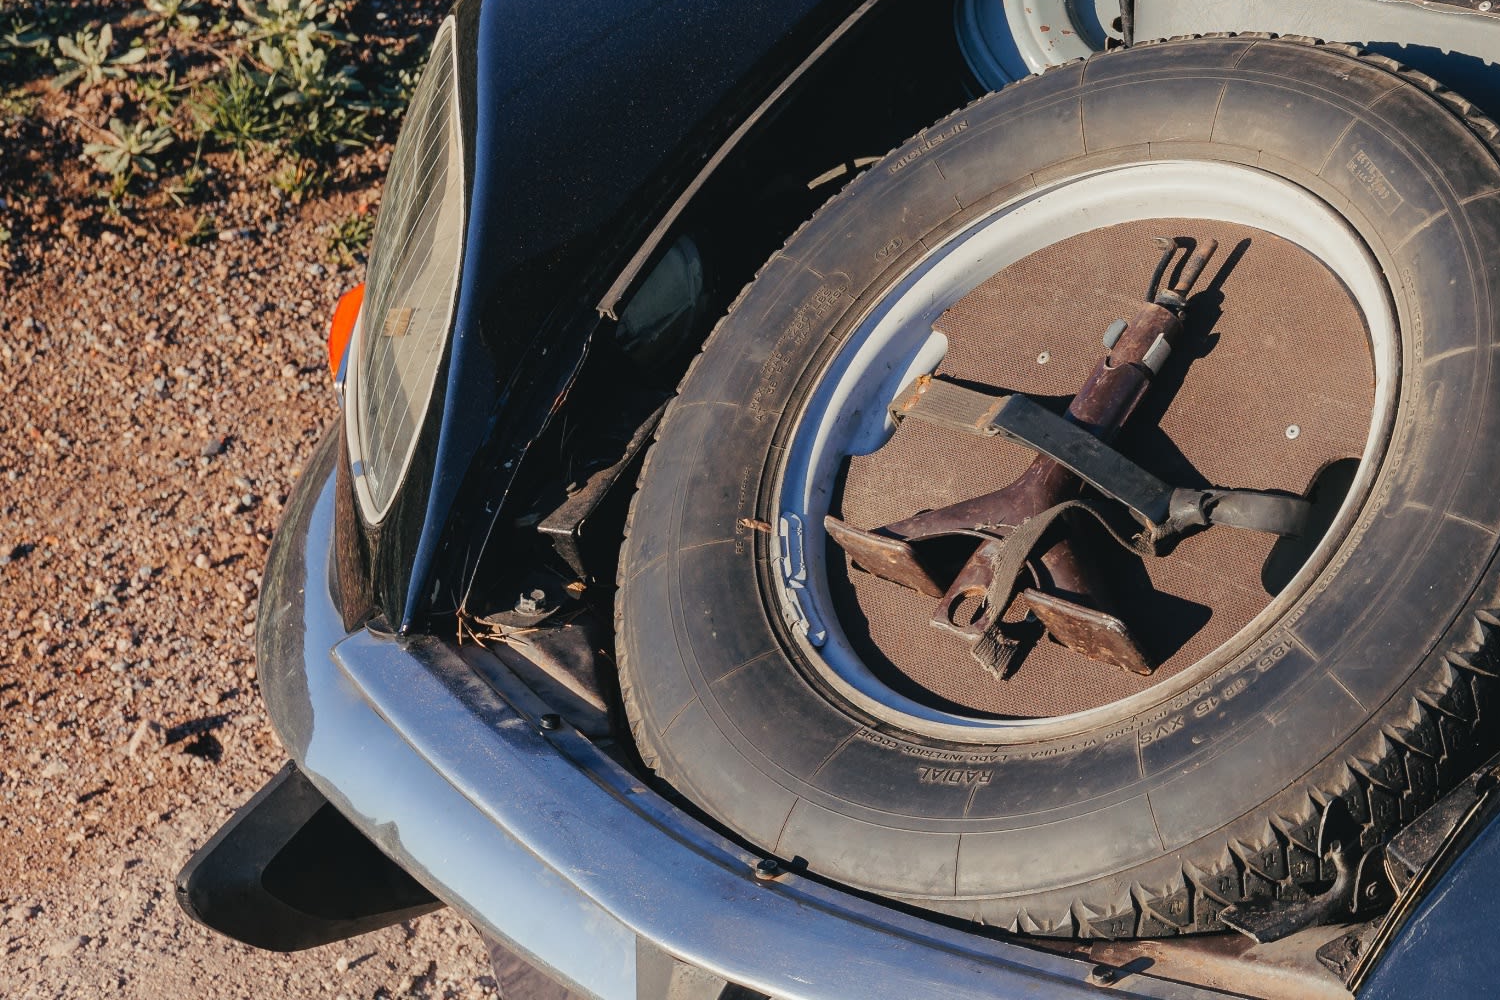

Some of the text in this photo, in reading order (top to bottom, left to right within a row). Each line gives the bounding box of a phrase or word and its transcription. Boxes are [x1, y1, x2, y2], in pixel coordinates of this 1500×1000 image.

[888, 119, 971, 175] MICHELIN
[1256, 636, 1296, 672] 185
[1173, 683, 1212, 711] LATO
[1193, 694, 1220, 717] 15
[1104, 708, 1168, 741] INTERNO
[1138, 714, 1185, 746] XVS
[855, 727, 899, 749] COCHE
[1029, 736, 1096, 758] VETTURA
[902, 745, 964, 761] INTERIOR
[968, 753, 1008, 761] LADO
[917, 766, 995, 783] RADIAL
